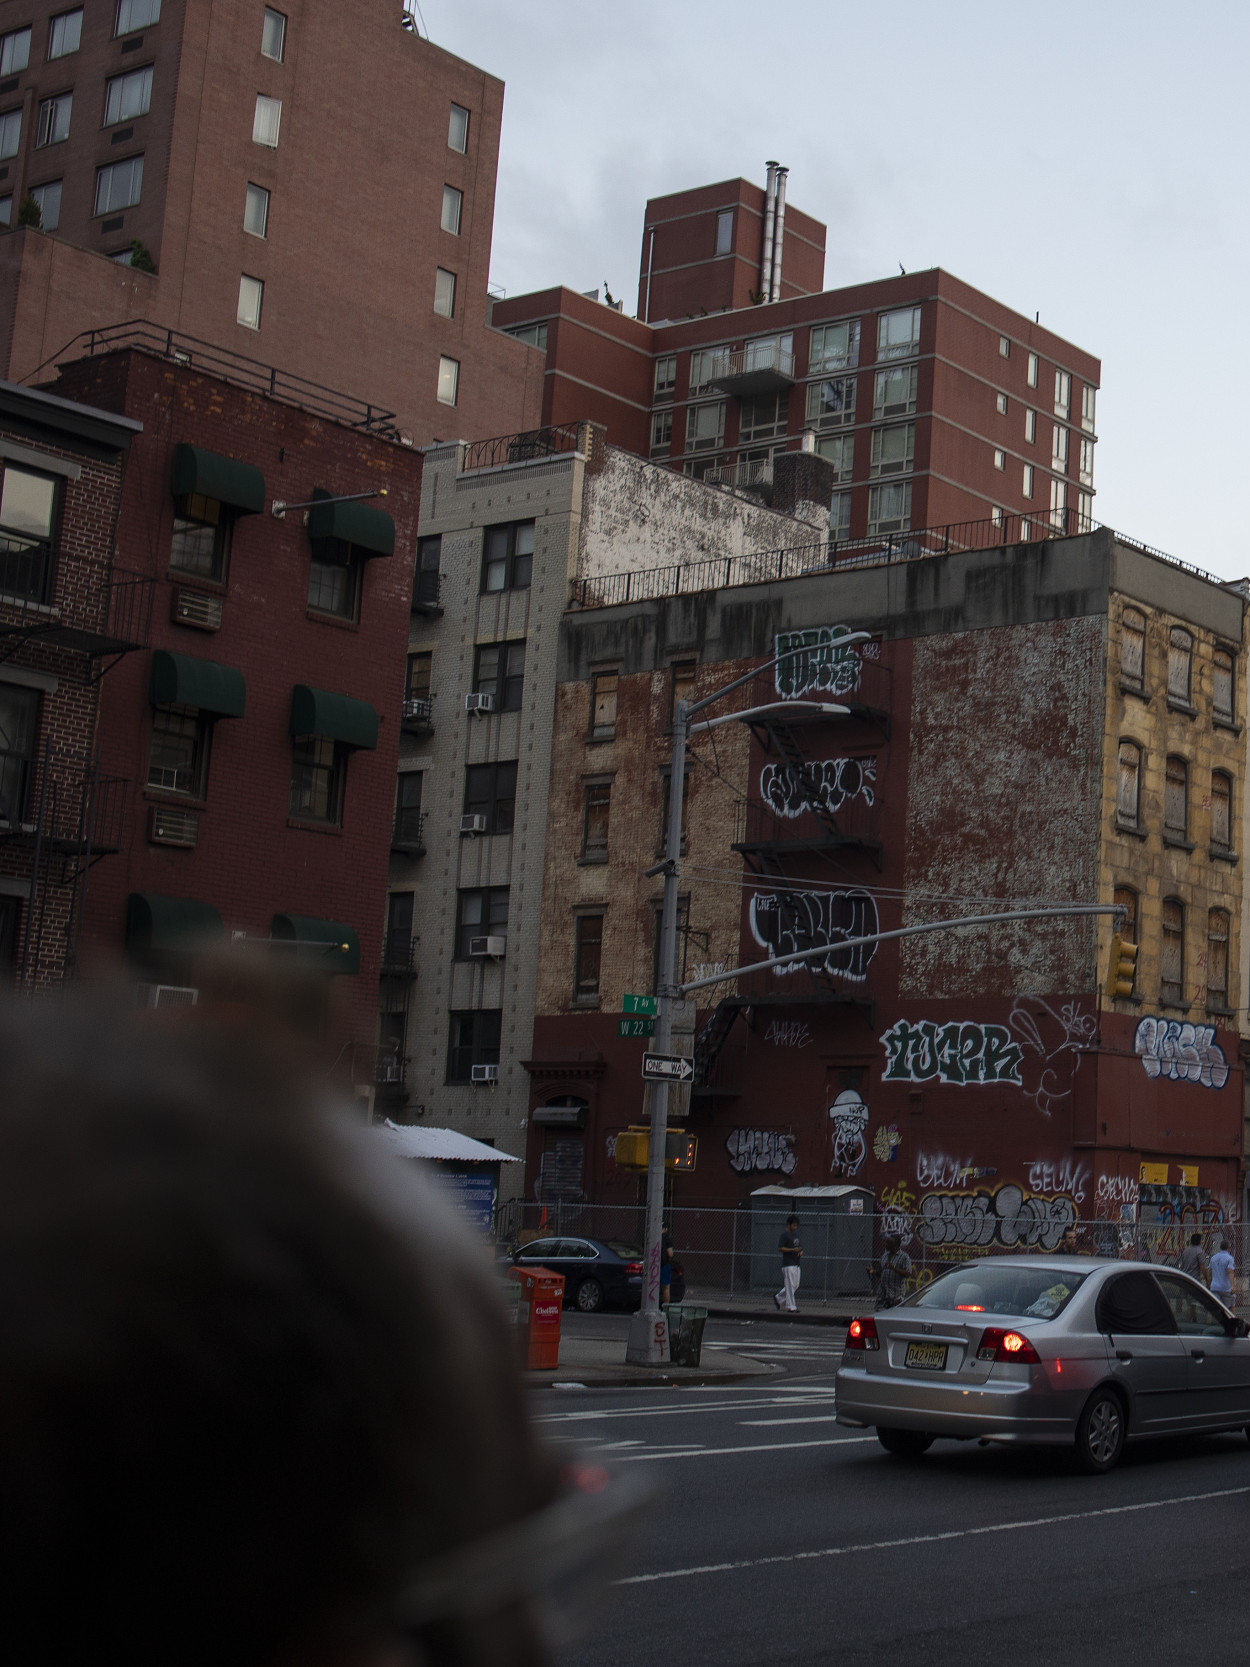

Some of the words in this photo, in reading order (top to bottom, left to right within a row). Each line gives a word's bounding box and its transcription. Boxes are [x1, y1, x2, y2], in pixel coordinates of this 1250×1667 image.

[633, 997, 639, 1011] 7
[621, 1021, 630, 1035] W
[633, 1021, 644, 1035] 22
[647, 1060, 664, 1072] ONE
[671, 1061, 688, 1073] WAY
